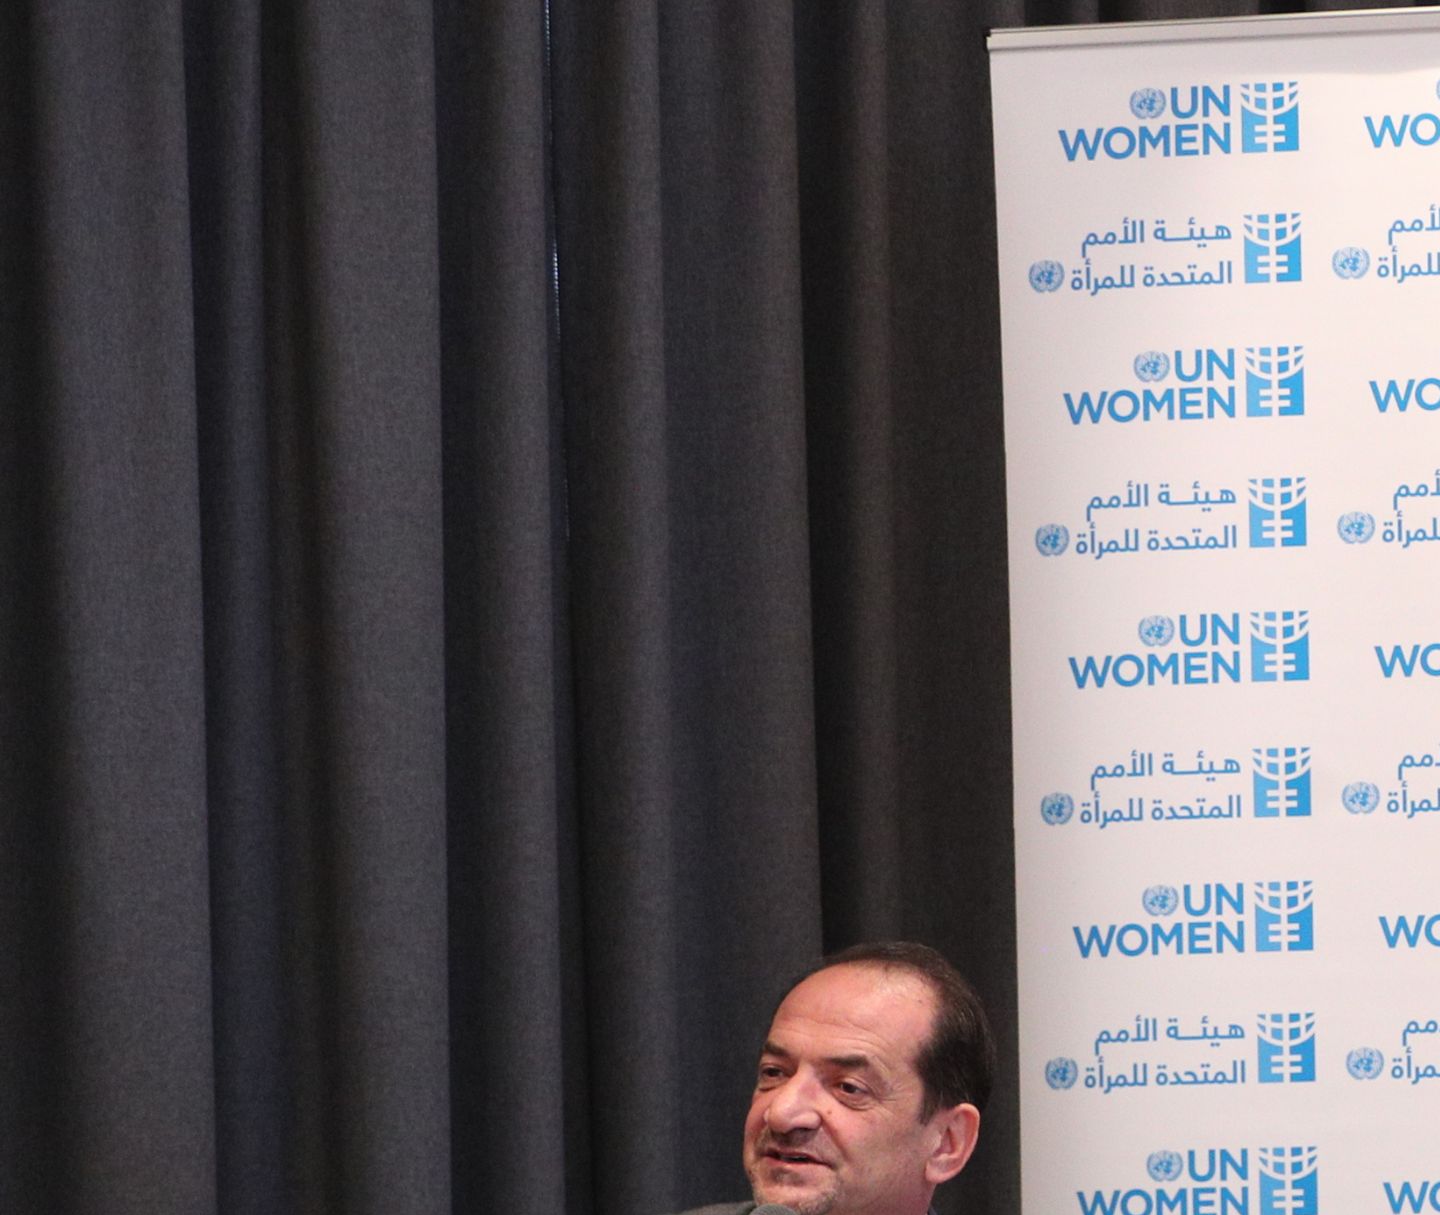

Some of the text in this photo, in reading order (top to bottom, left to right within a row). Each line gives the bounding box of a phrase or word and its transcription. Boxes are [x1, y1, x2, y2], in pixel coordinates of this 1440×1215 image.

[1169, 83, 1232, 121] UN
[1057, 121, 1233, 162] WOMEN
[1080, 218, 1233, 257] هيئة الأمم
[1070, 257, 1233, 296] المتحدة للمرأة
[1173, 346, 1237, 385] UN
[1062, 383, 1237, 426] WOMEN
[1086, 482, 1238, 530] هيئة الأمم
[1074, 524, 1238, 561] المتحدة للمرأة
[1178, 610, 1242, 649] UN
[1067, 649, 1243, 689] WOMEN
[1089, 751, 1242, 792] هيئة الأمم
[1079, 792, 1243, 830] المتحدة للمرأة
[1182, 880, 1246, 918] UN
[1072, 919, 1247, 959] WOMEN
[1092, 1016, 1247, 1056] هيئة الأمم
[1083, 1058, 1247, 1094] المتحدة للمرأة
[1186, 1147, 1250, 1184] UN
